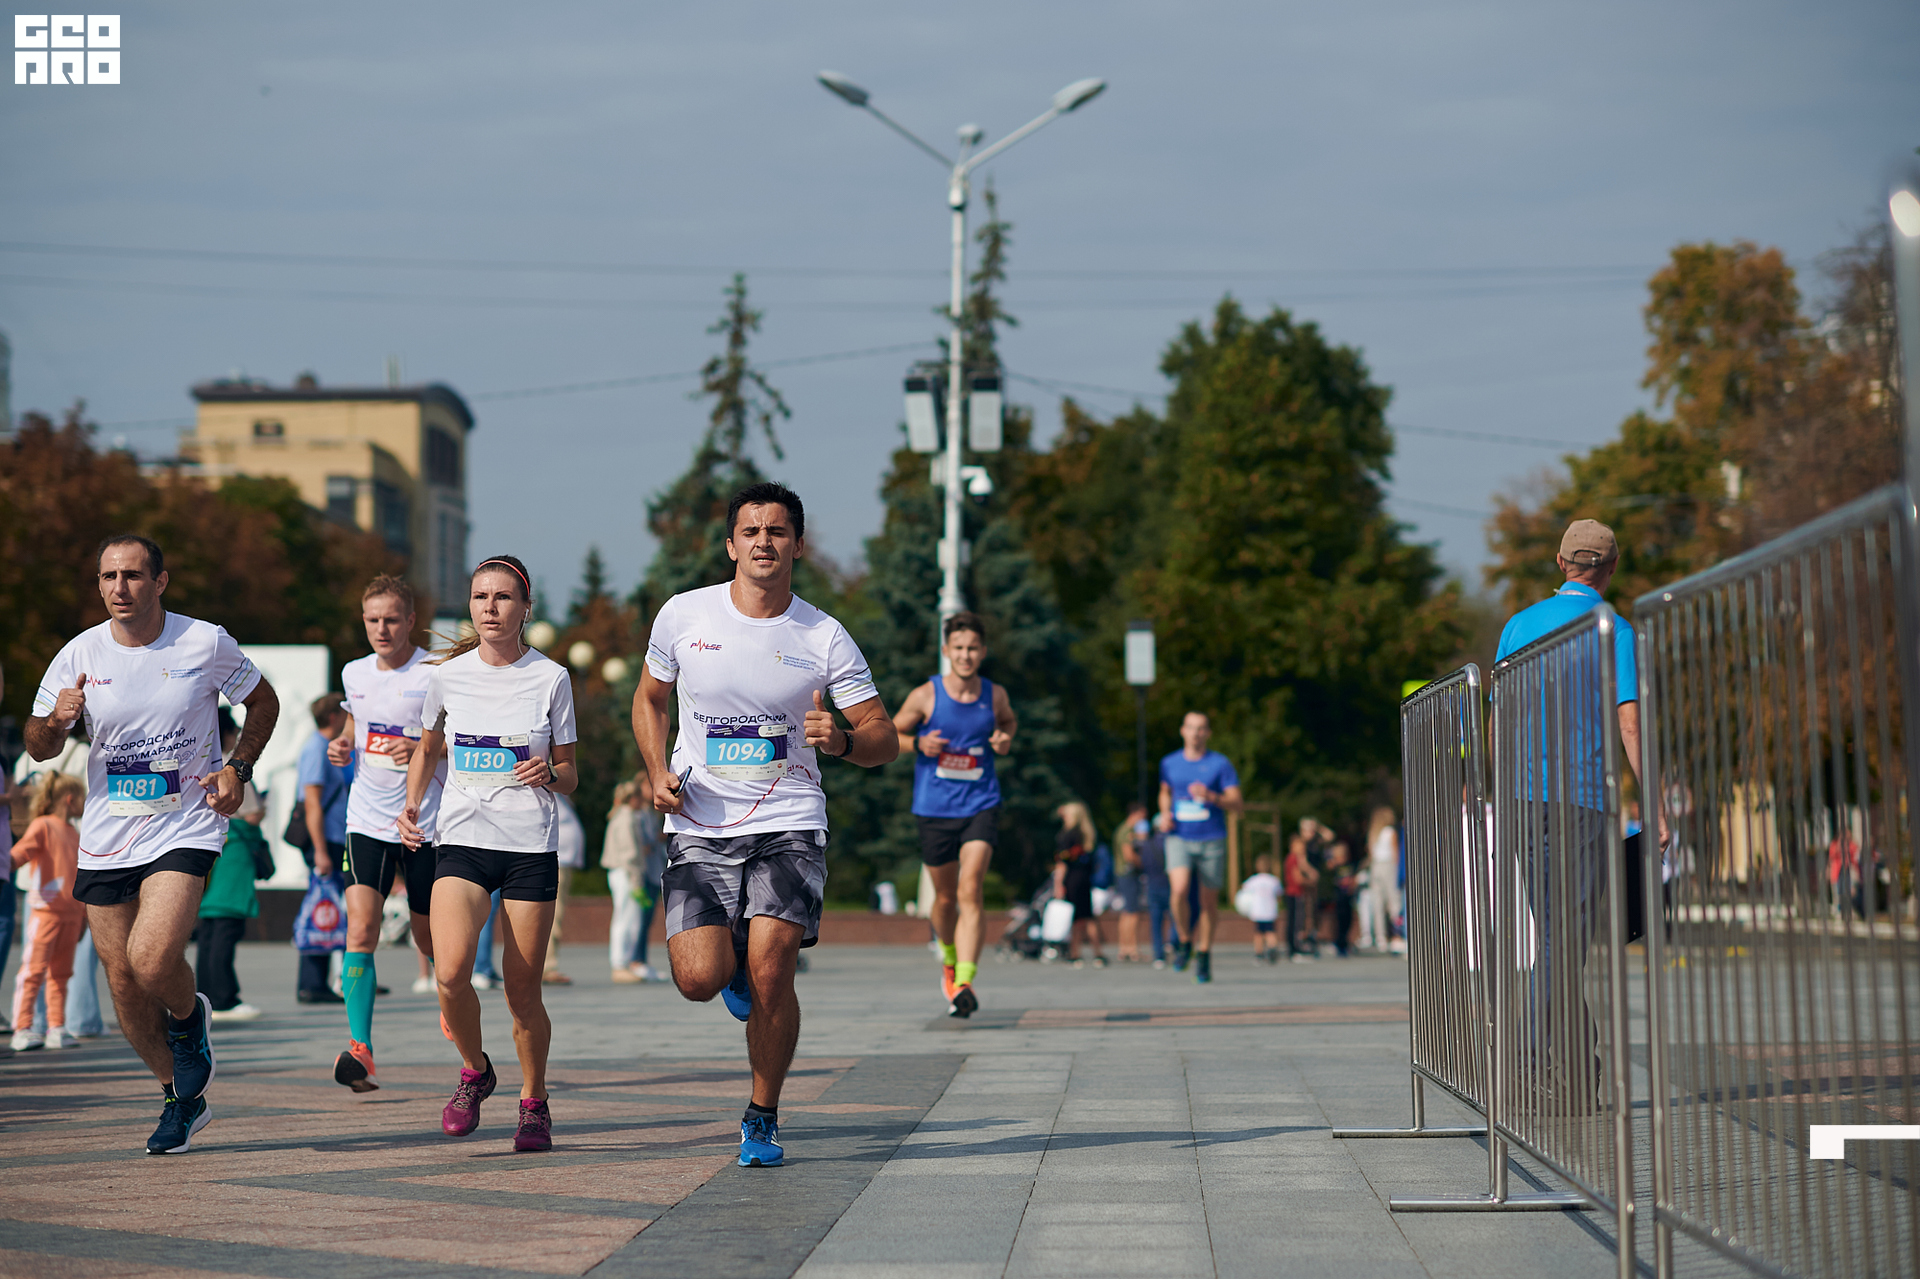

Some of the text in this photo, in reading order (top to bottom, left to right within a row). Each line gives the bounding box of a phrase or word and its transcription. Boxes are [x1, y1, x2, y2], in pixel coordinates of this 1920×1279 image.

[693, 711, 787, 725] БЕЛГОРОДСКИЙ
[369, 735, 390, 753] 22
[718, 742, 767, 762] 1094
[464, 751, 505, 769] 1130
[116, 777, 157, 798] 1081
